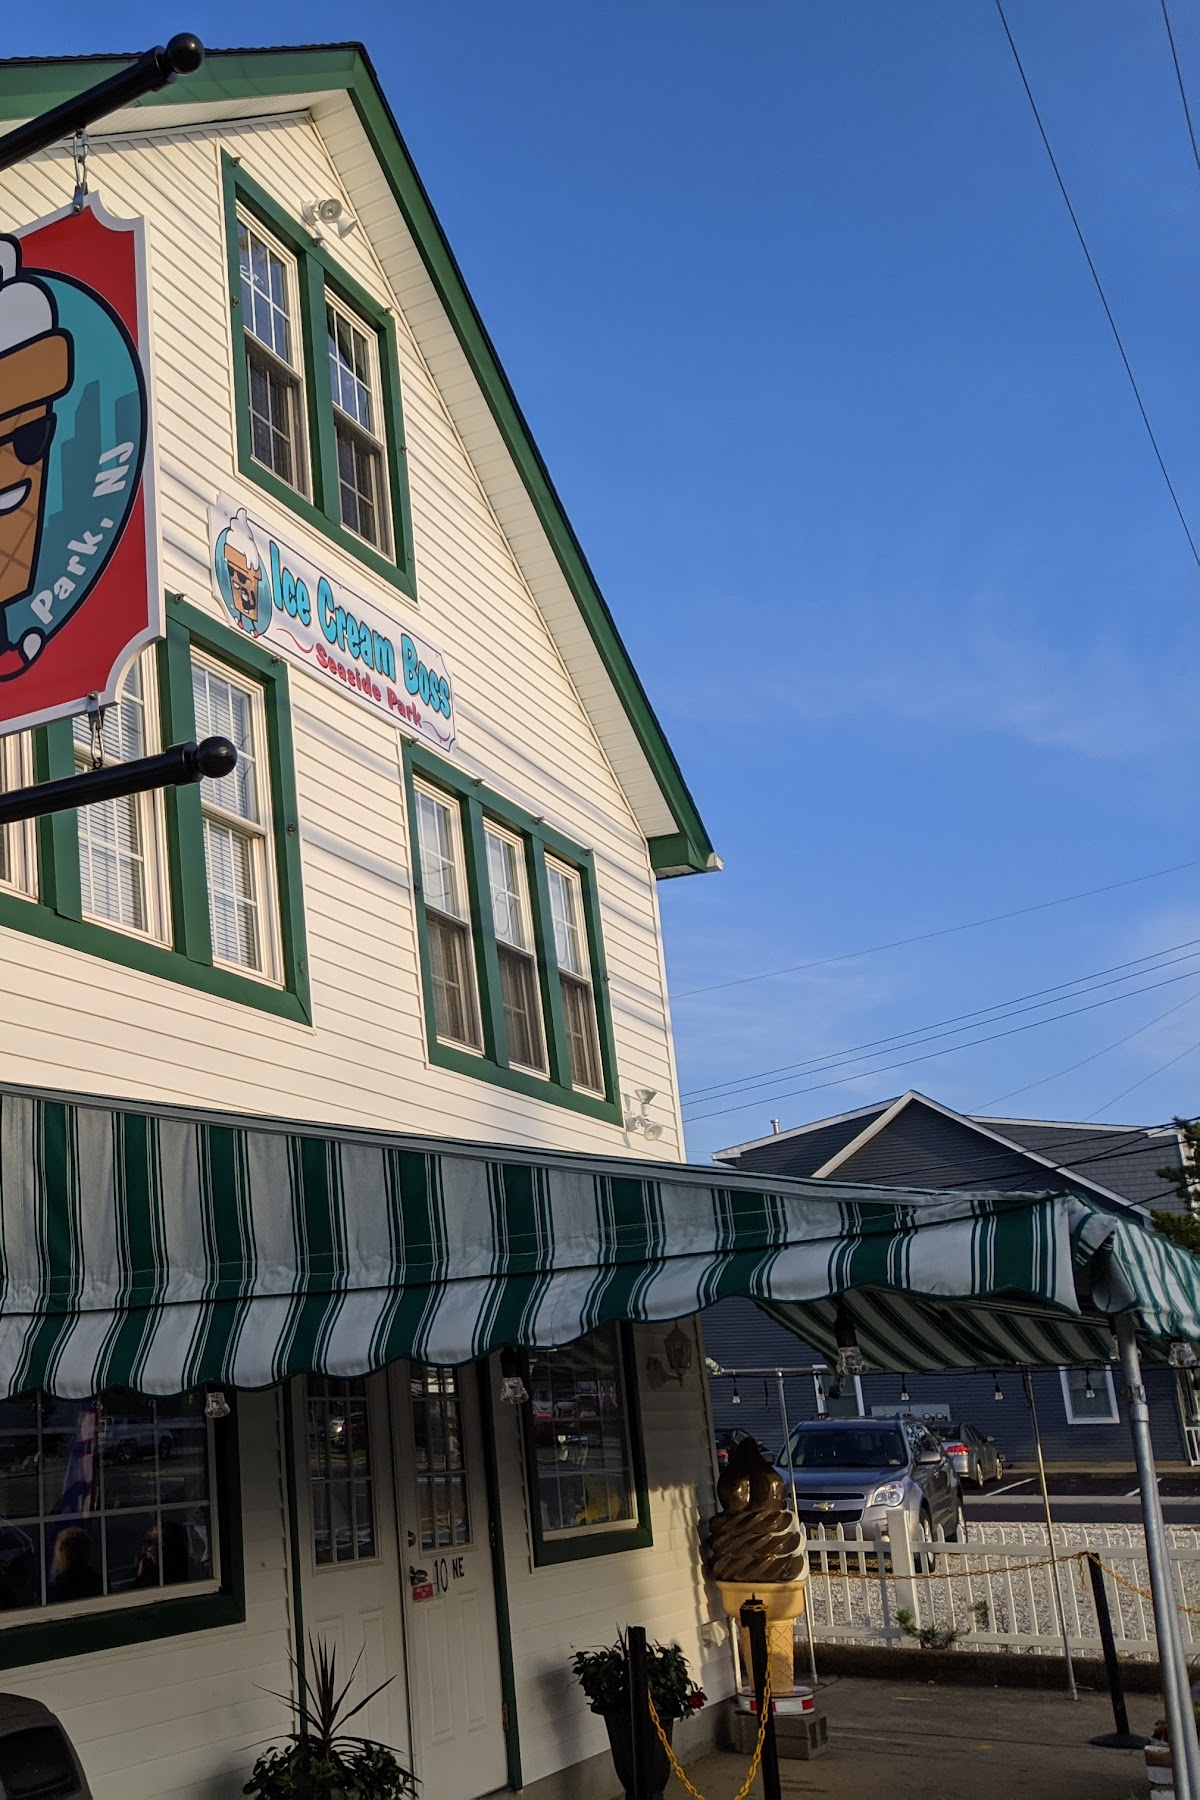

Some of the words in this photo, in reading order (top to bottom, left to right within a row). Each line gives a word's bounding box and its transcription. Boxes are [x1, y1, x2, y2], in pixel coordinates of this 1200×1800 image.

[31, 518, 114, 624] Park,
[93, 442, 134, 497] NJ
[269, 540, 311, 626] Ice
[317, 576, 396, 683] Cream
[401, 632, 451, 719] Boss
[315, 643, 382, 701] Seaside
[387, 686, 422, 728] Park
[435, 1558, 448, 1593] 10
[452, 1557, 465, 1579] NE
